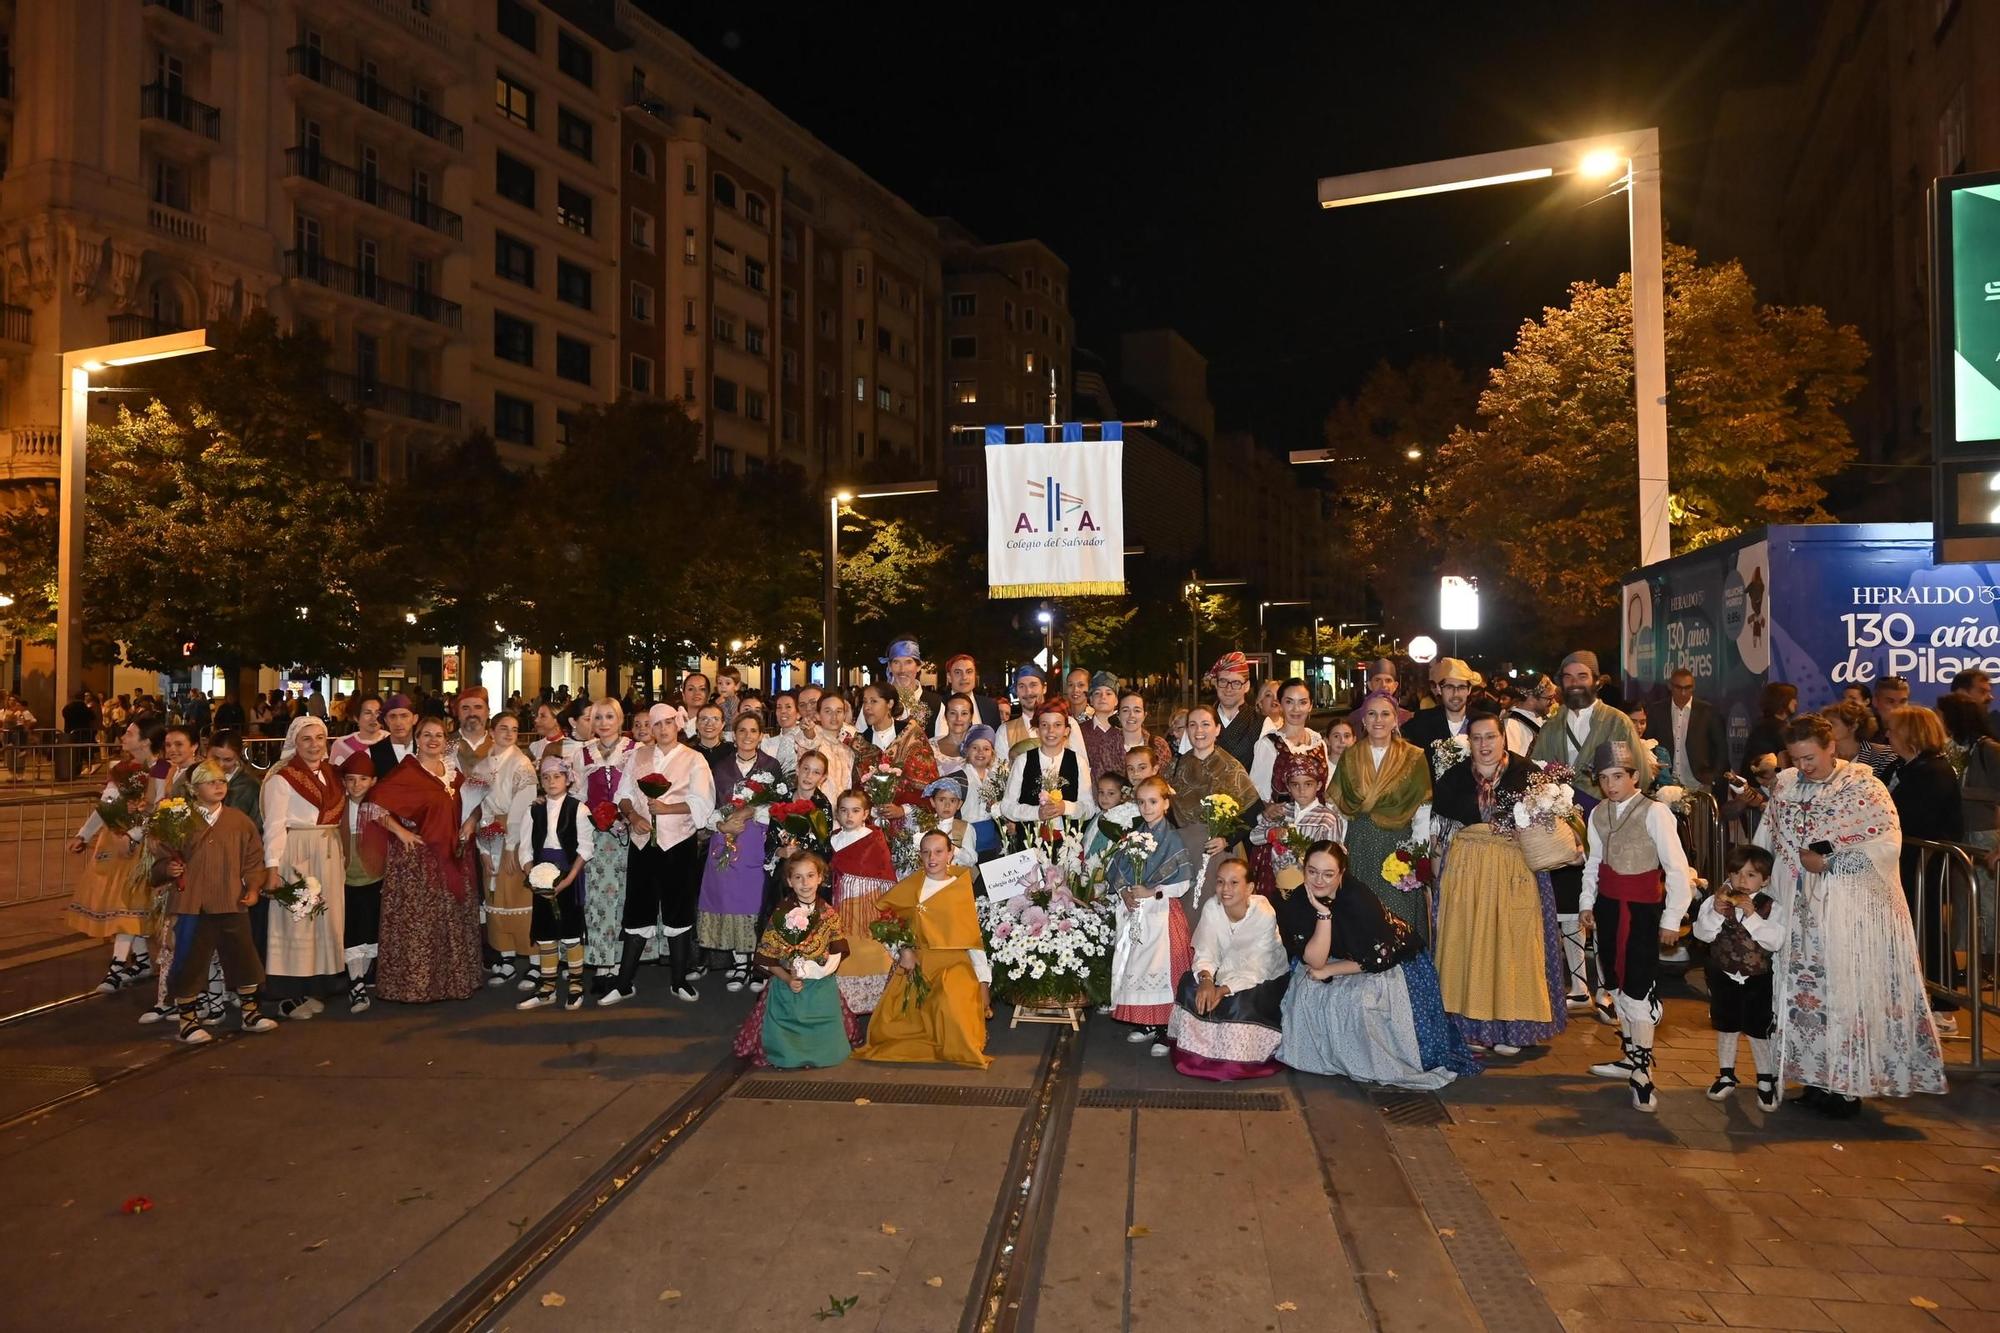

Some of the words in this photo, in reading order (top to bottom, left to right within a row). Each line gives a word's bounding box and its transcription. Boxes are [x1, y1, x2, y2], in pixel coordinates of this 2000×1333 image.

[1006, 539, 1041, 551] Colegio
[1044, 537, 1060, 548] del
[1062, 536, 1105, 548] Salvador
[1670, 592, 1698, 612] HERALDO
[1852, 586, 1974, 605] HERALDO
[1666, 622, 1685, 651] 130
[1687, 623, 1710, 648] años
[1840, 612, 1915, 648] 130
[1663, 651, 1675, 680] de
[1677, 649, 1713, 677] Pilares
[1831, 648, 1876, 683] de
